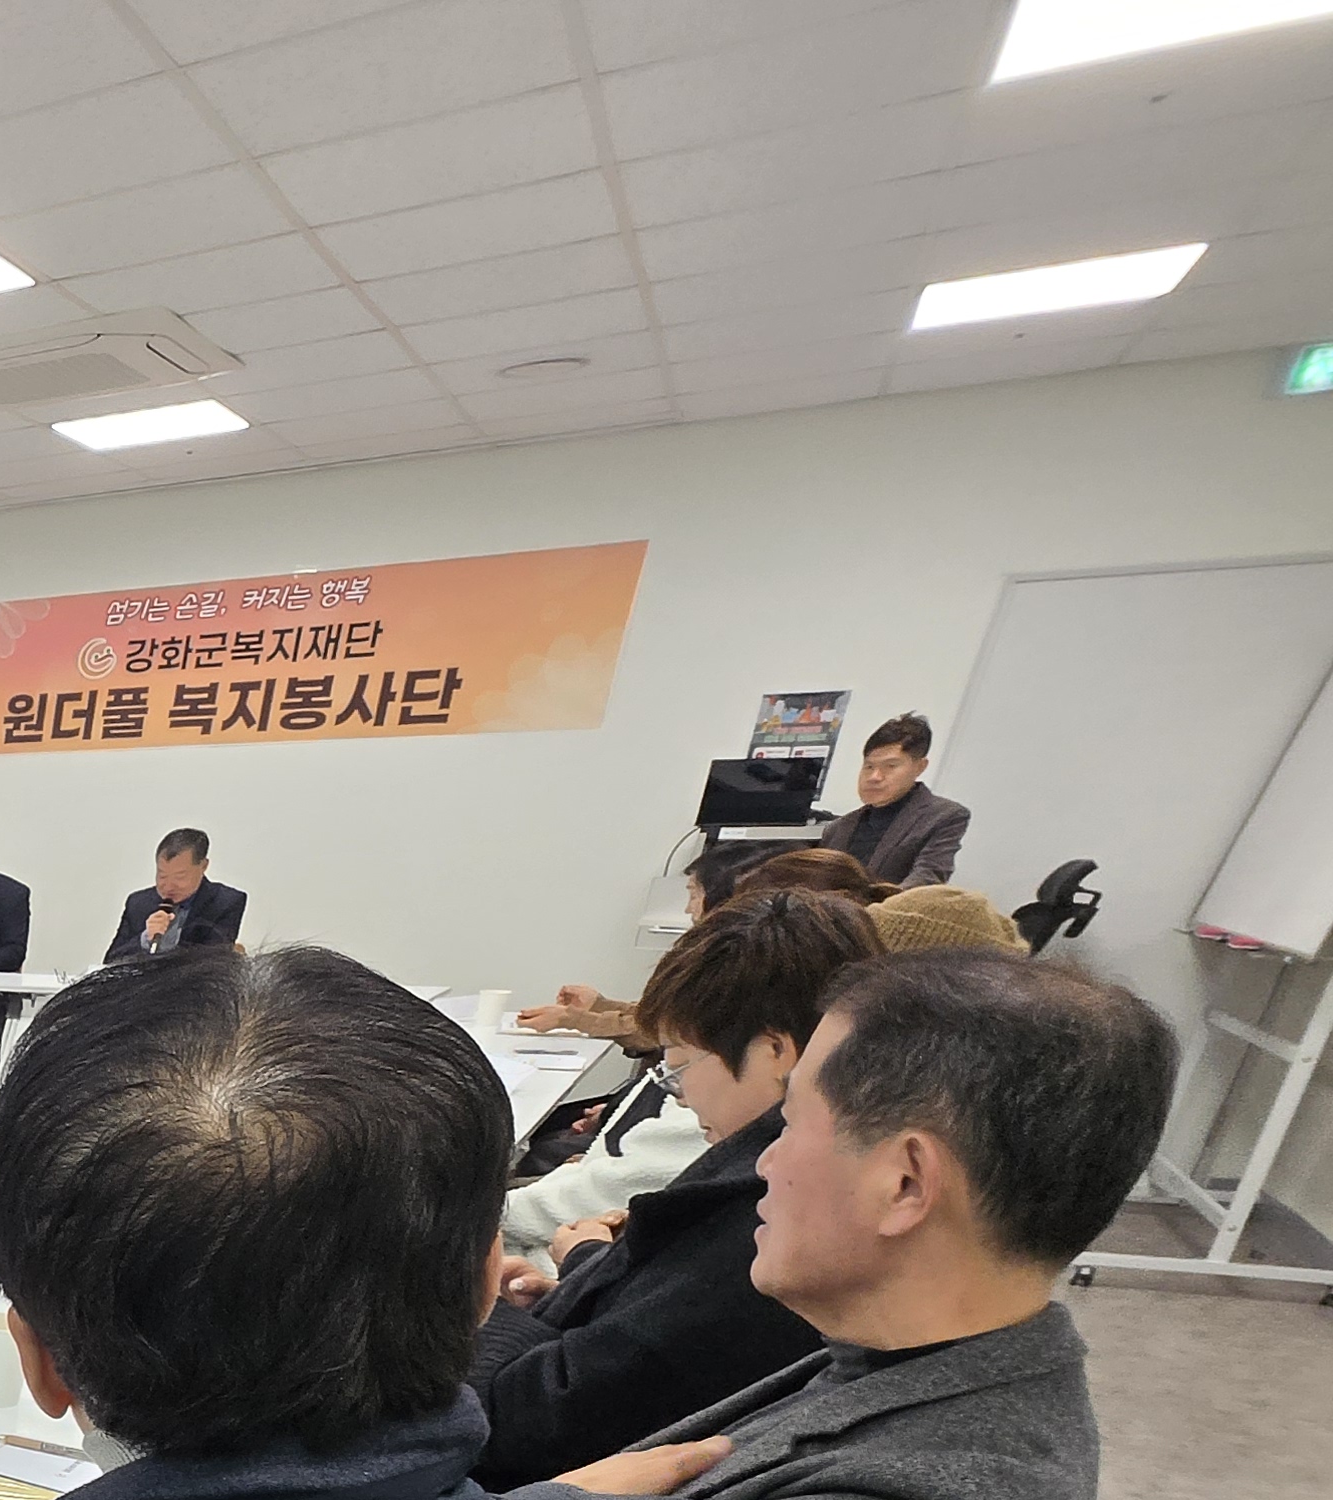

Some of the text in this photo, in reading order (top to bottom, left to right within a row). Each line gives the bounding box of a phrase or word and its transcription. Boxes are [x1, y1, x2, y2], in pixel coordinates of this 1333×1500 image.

[105, 577, 372, 626] 섬기는 손길, 커지는 행복
[123, 618, 384, 675] 강화군복지재단
[2, 666, 464, 744] 원더풀 복지봉사단
